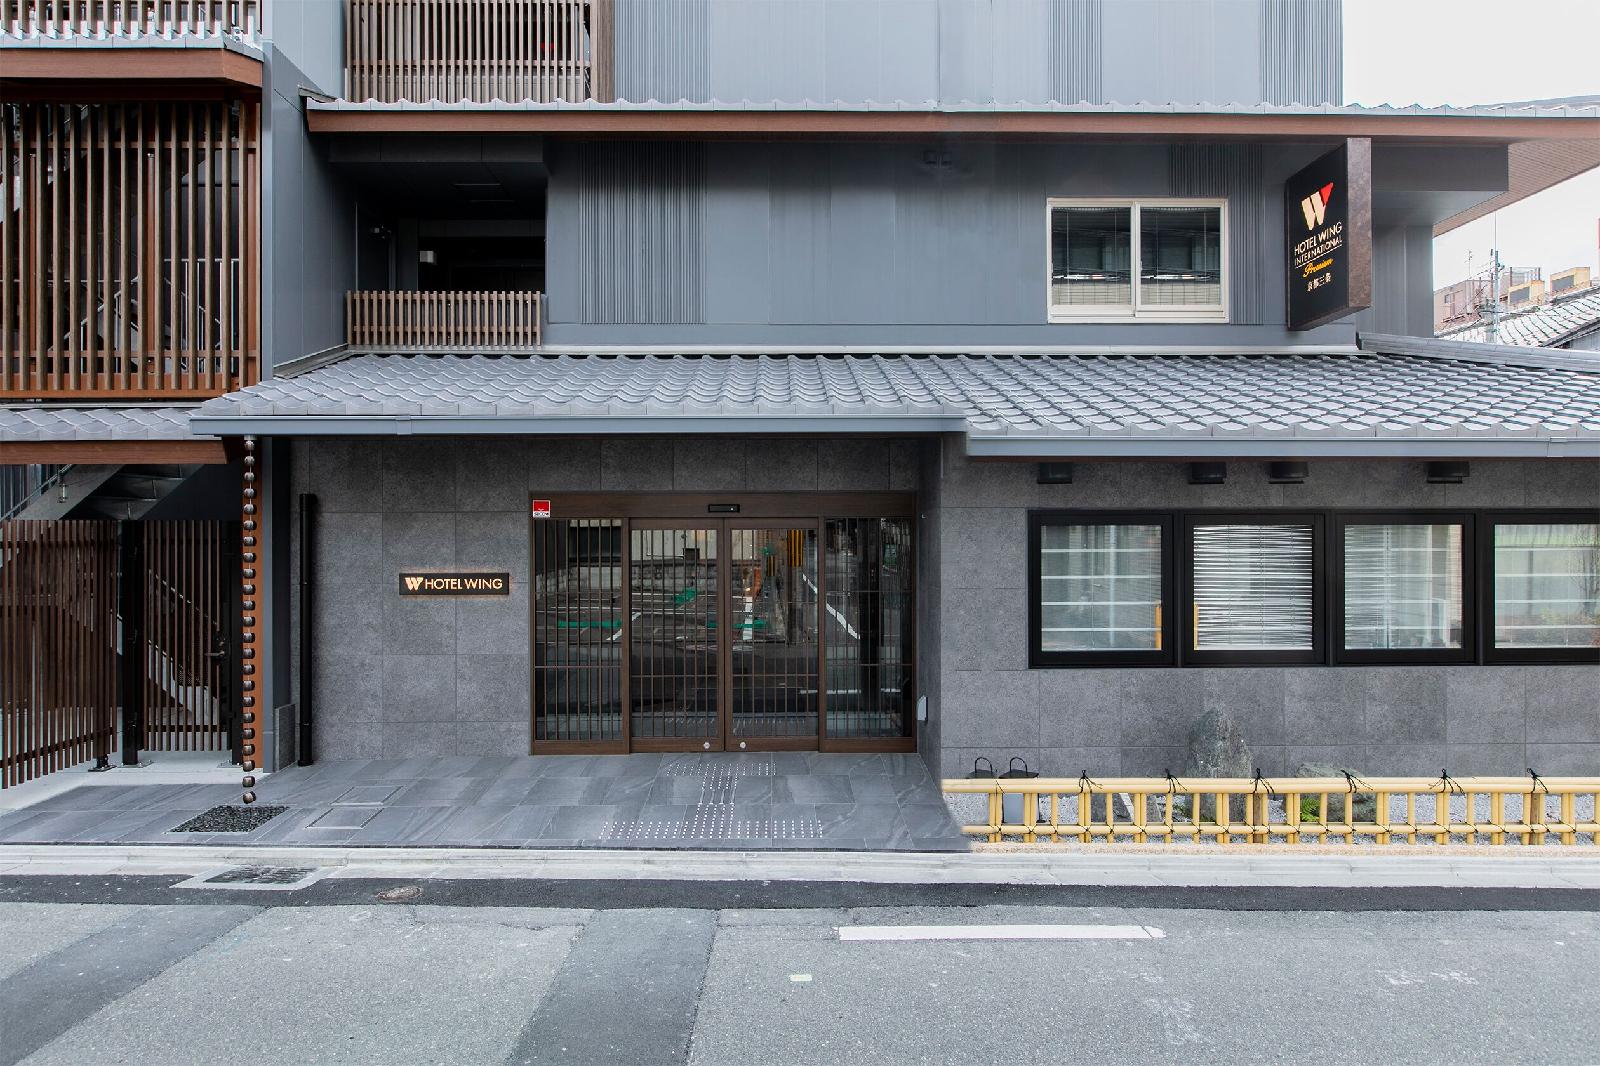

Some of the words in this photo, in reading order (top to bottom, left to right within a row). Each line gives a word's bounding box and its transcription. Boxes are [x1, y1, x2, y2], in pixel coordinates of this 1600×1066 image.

[1294, 235, 1317, 256] HOTEL
[1318, 221, 1343, 243] WING
[1294, 237, 1342, 266] INTERNATIONAL
[1303, 258, 1334, 278] Premium
[424, 578, 463, 590] HOTEL
[464, 578, 503, 590] WING
